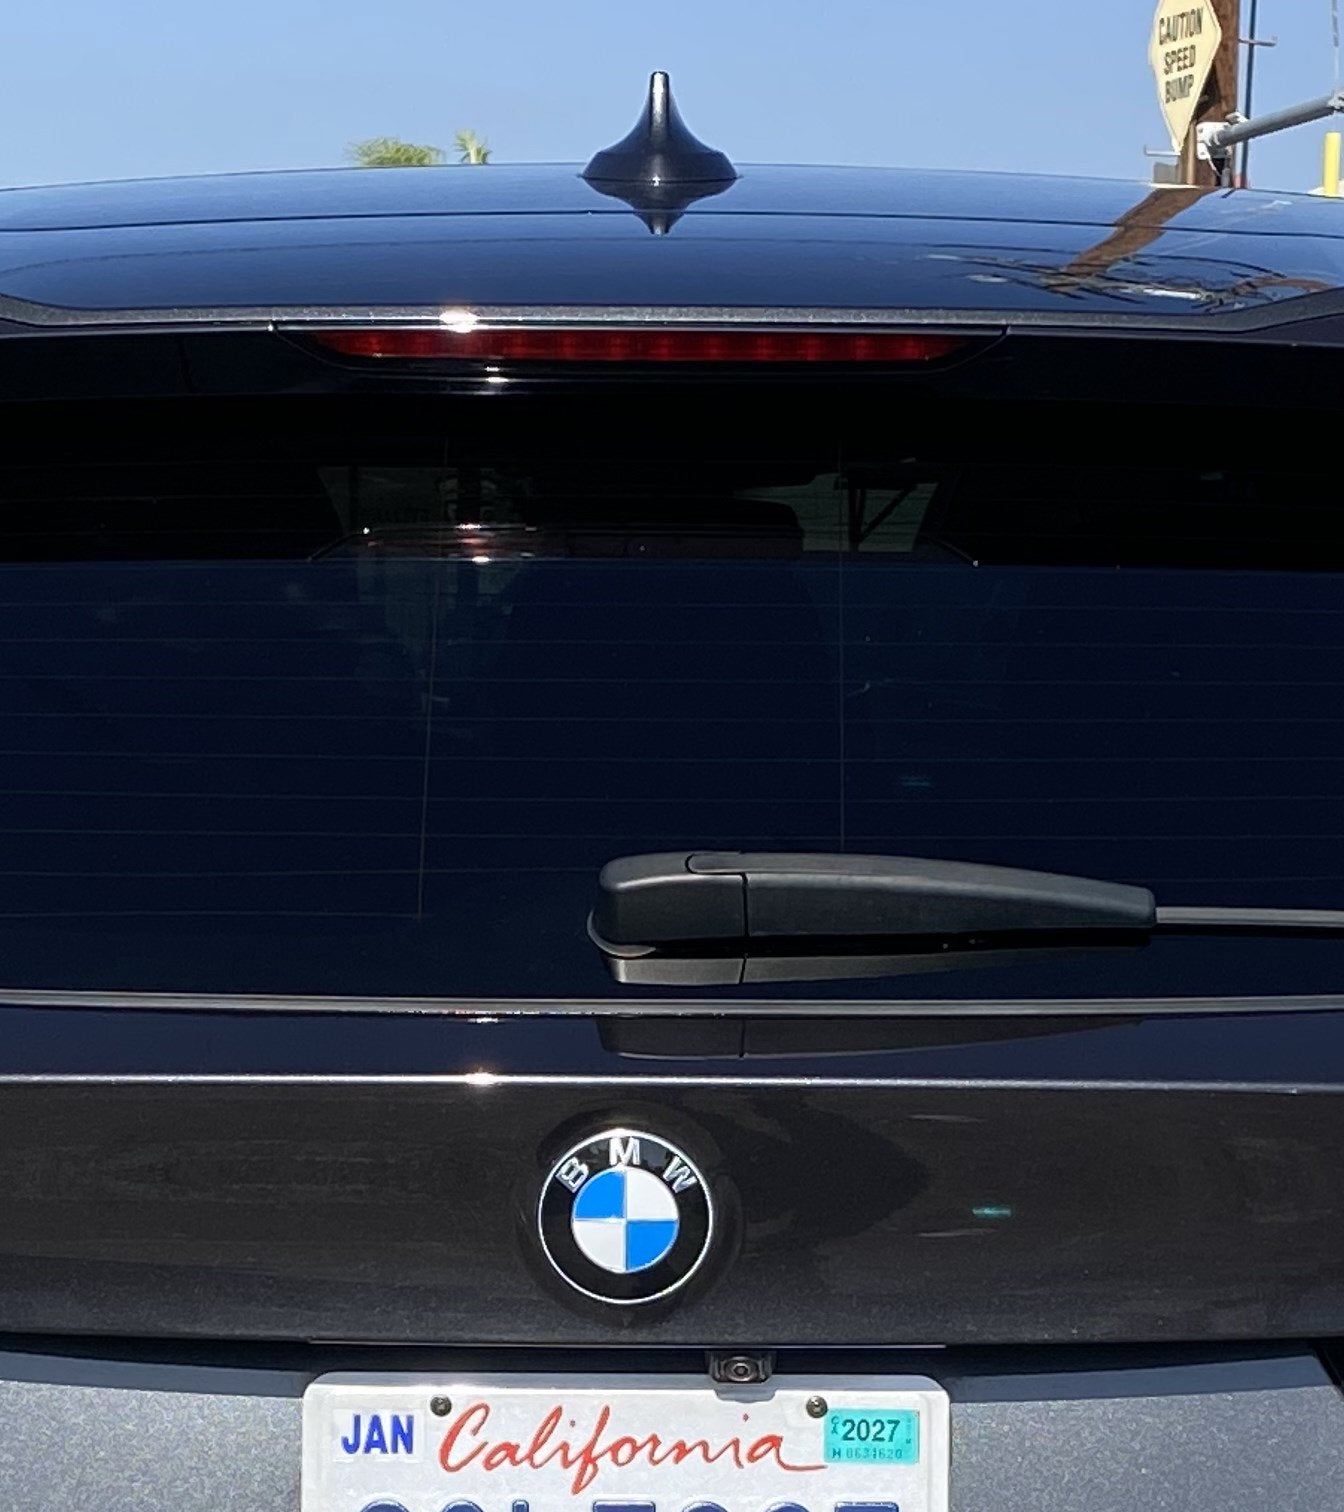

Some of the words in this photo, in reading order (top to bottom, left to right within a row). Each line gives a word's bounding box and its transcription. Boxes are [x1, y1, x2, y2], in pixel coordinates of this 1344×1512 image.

[1159, 7, 1203, 45] CAUTION
[1164, 45, 1195, 75] SPEED
[1165, 74, 1194, 103] BUMP
[556, 1136, 698, 1194] BMW
[341, 1414, 414, 1455] JAN
[438, 1402, 827, 1495] California
[842, 1418, 900, 1442] 2027
